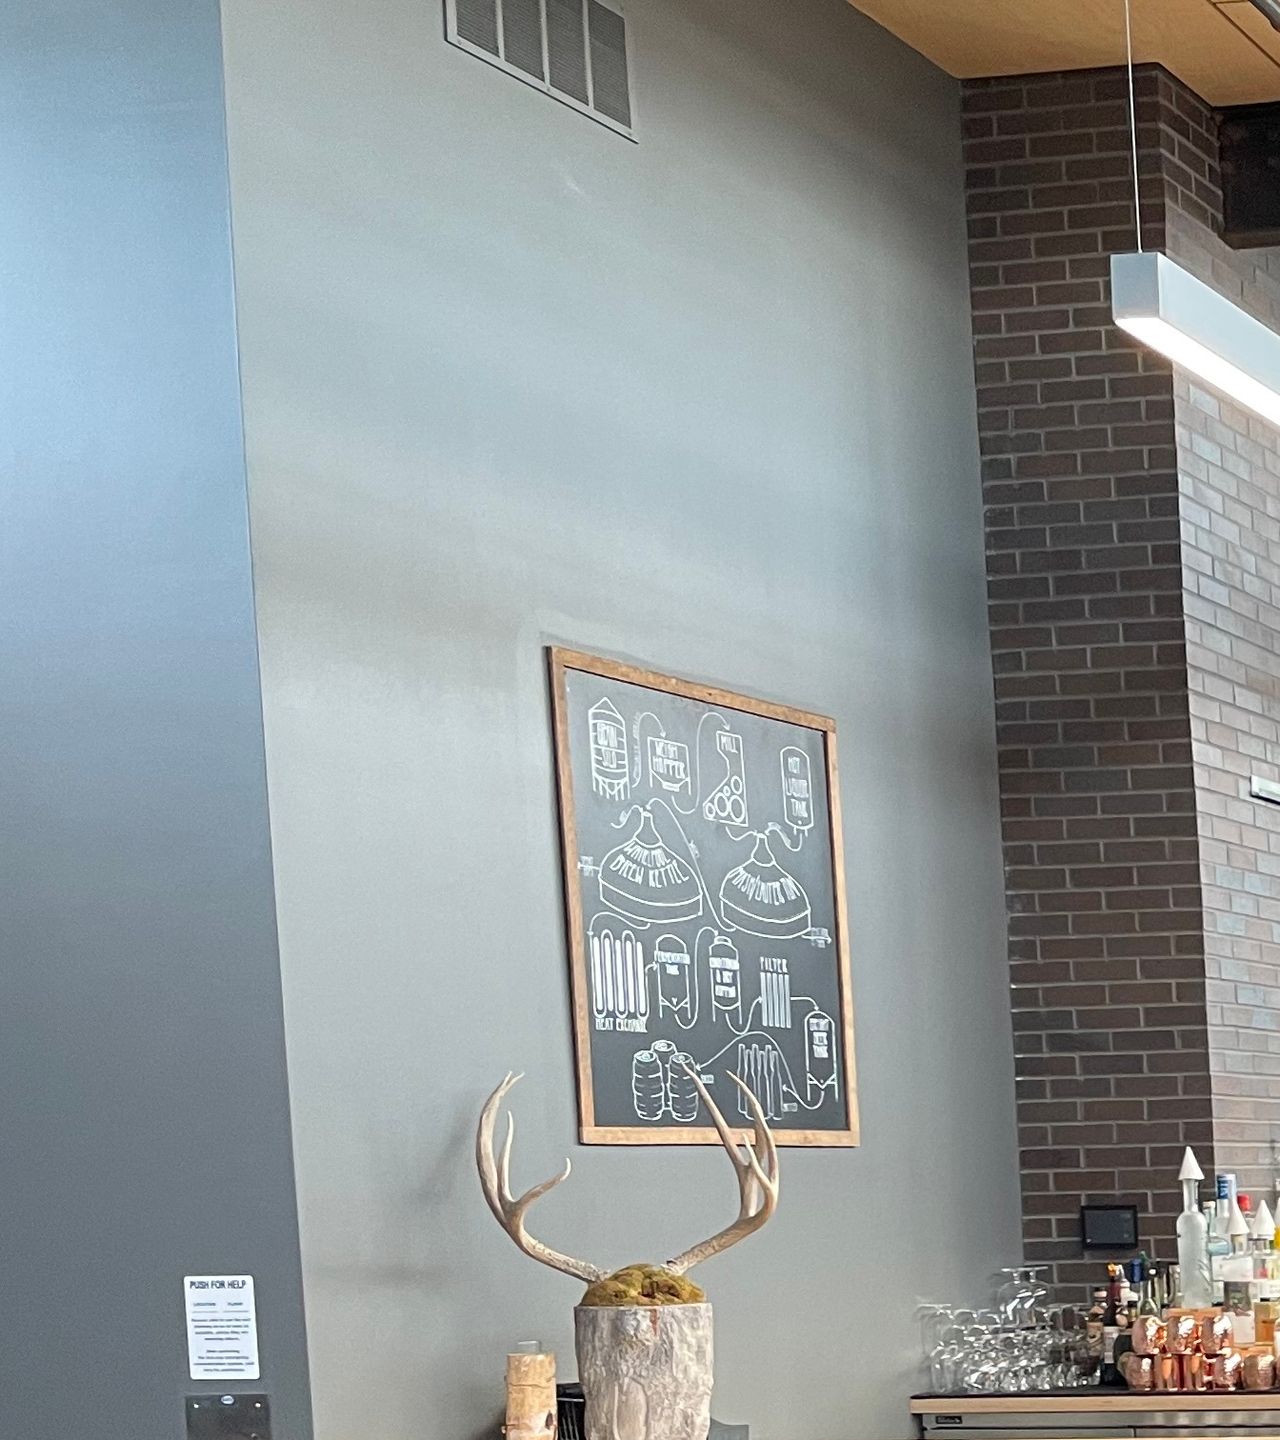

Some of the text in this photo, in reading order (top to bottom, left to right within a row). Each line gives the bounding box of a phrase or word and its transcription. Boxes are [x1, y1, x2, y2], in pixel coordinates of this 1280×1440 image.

[759, 956, 789, 973] FILTER
[190, 1280, 246, 1289] PUSH FOR HELP
